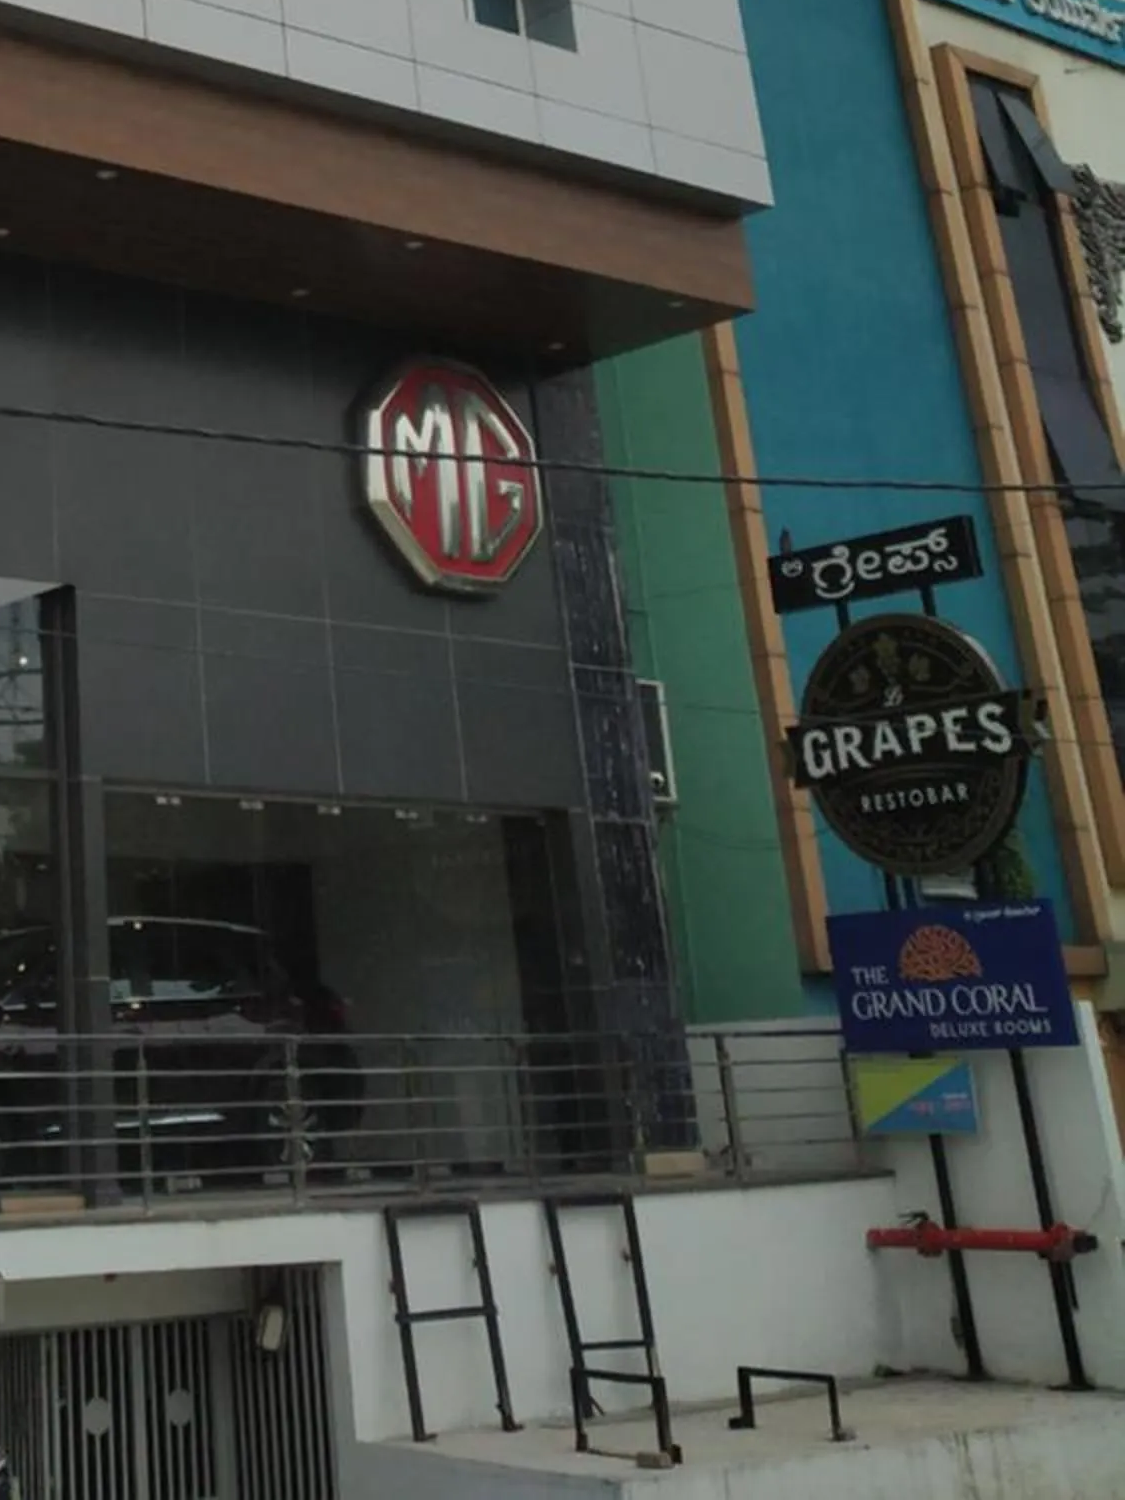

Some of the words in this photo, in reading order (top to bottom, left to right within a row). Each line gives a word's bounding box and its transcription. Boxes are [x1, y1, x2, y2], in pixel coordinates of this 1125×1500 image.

[392, 384, 524, 562] MG
[802, 702, 1013, 780] GRAPES
[861, 782, 970, 813] RESTOBAR
[851, 965, 889, 985] THE
[852, 987, 946, 1021] GRAND
[951, 983, 1049, 1016] CORAL
[930, 1021, 989, 1039] DELUXE
[994, 1018, 1052, 1036] ROOMS
